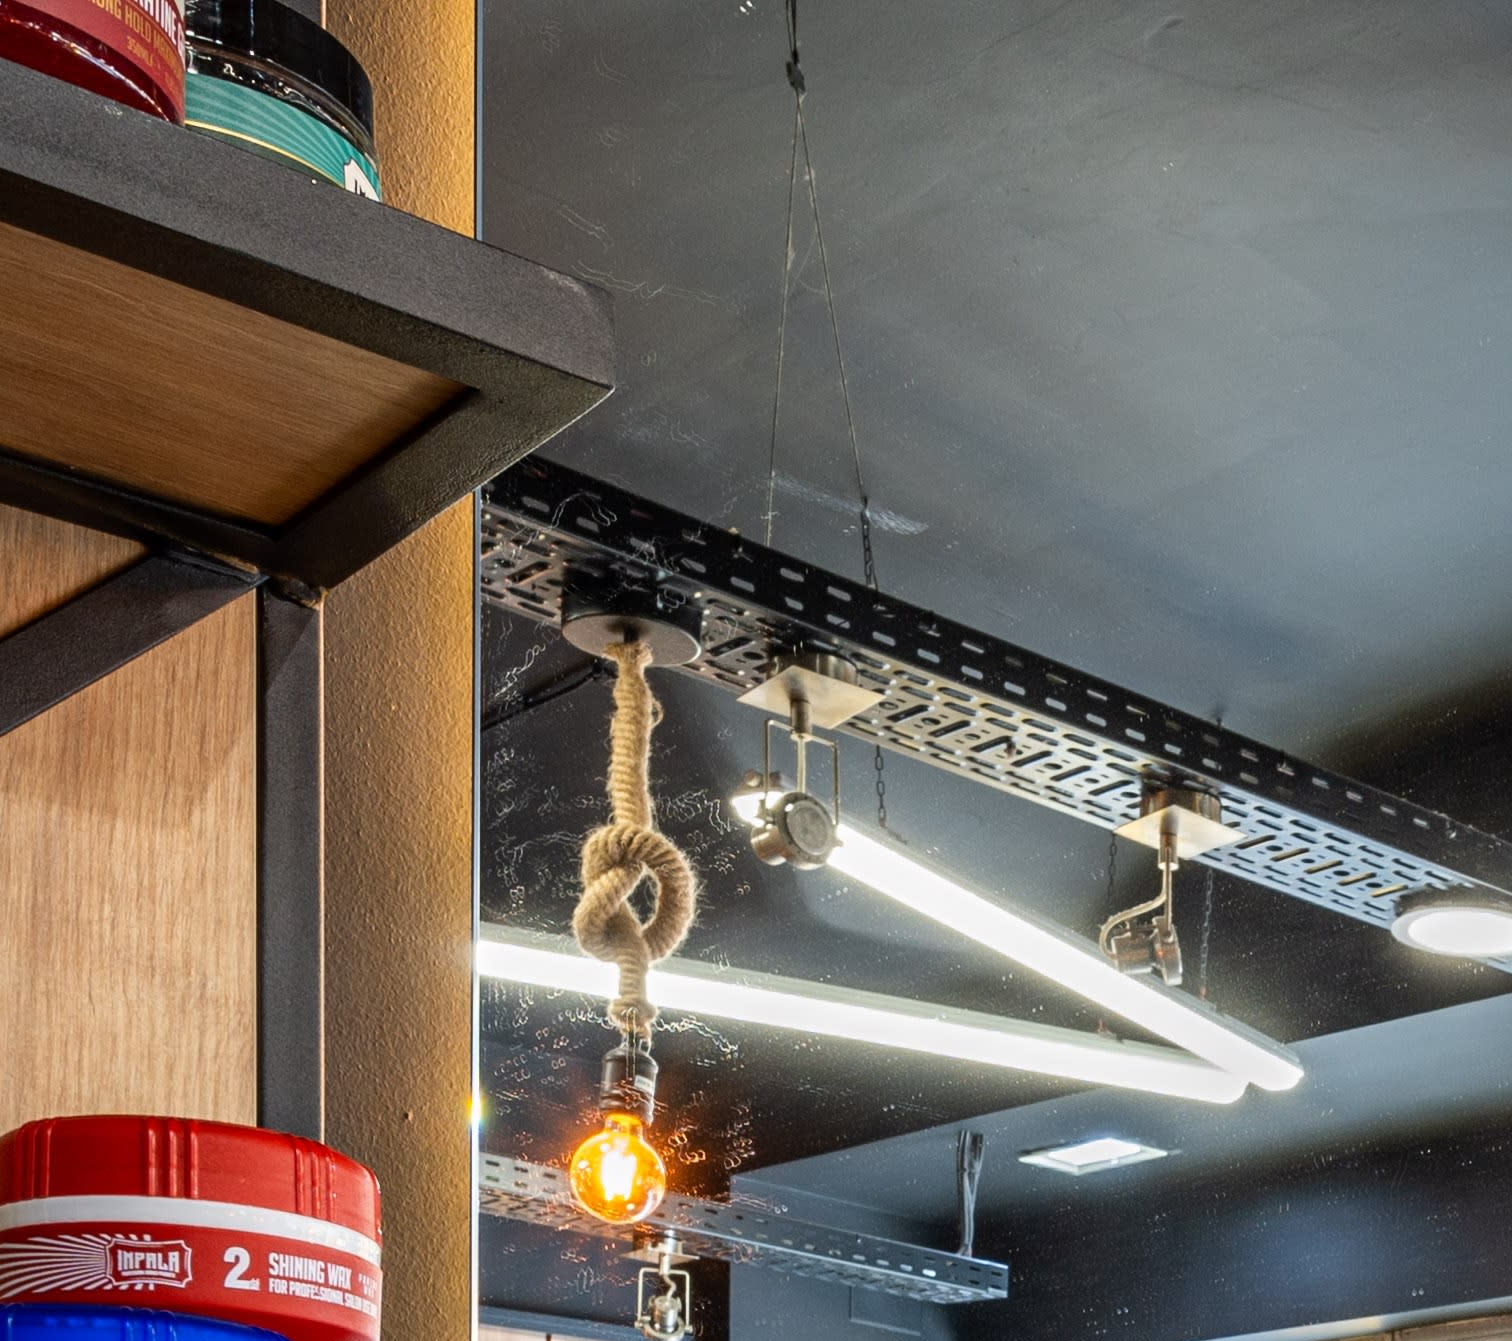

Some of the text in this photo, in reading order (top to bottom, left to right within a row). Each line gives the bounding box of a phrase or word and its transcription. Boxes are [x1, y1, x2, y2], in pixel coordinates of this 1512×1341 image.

[117, 1249, 180, 1273] IMPALA
[268, 1252, 354, 1291] SHINING WAX
[268, 1278, 289, 1294] FOR
